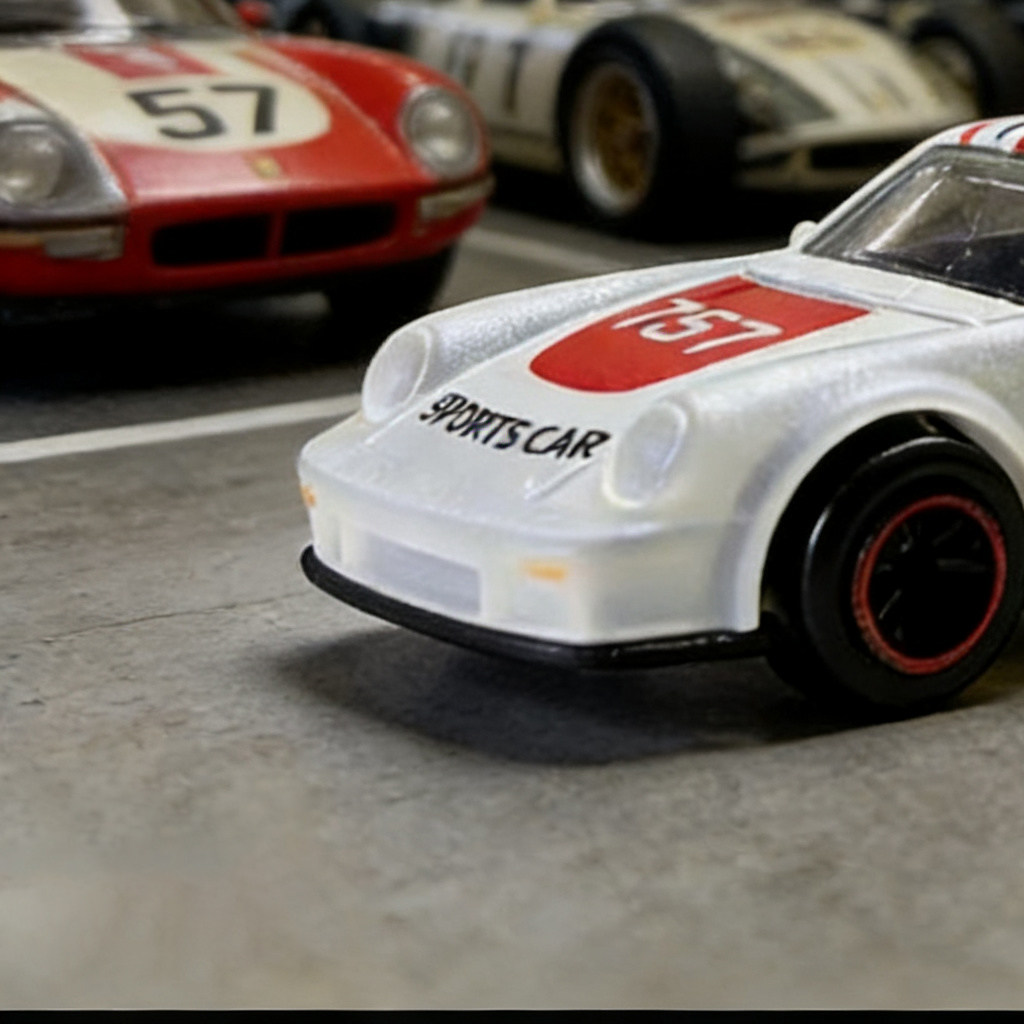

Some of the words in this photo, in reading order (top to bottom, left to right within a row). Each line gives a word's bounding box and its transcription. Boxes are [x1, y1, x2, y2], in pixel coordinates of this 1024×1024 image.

[126, 83, 277, 140] 57
[612, 297, 783, 355] 757
[419, 392, 531, 450] SPORTS
[523, 425, 612, 459] CAR
